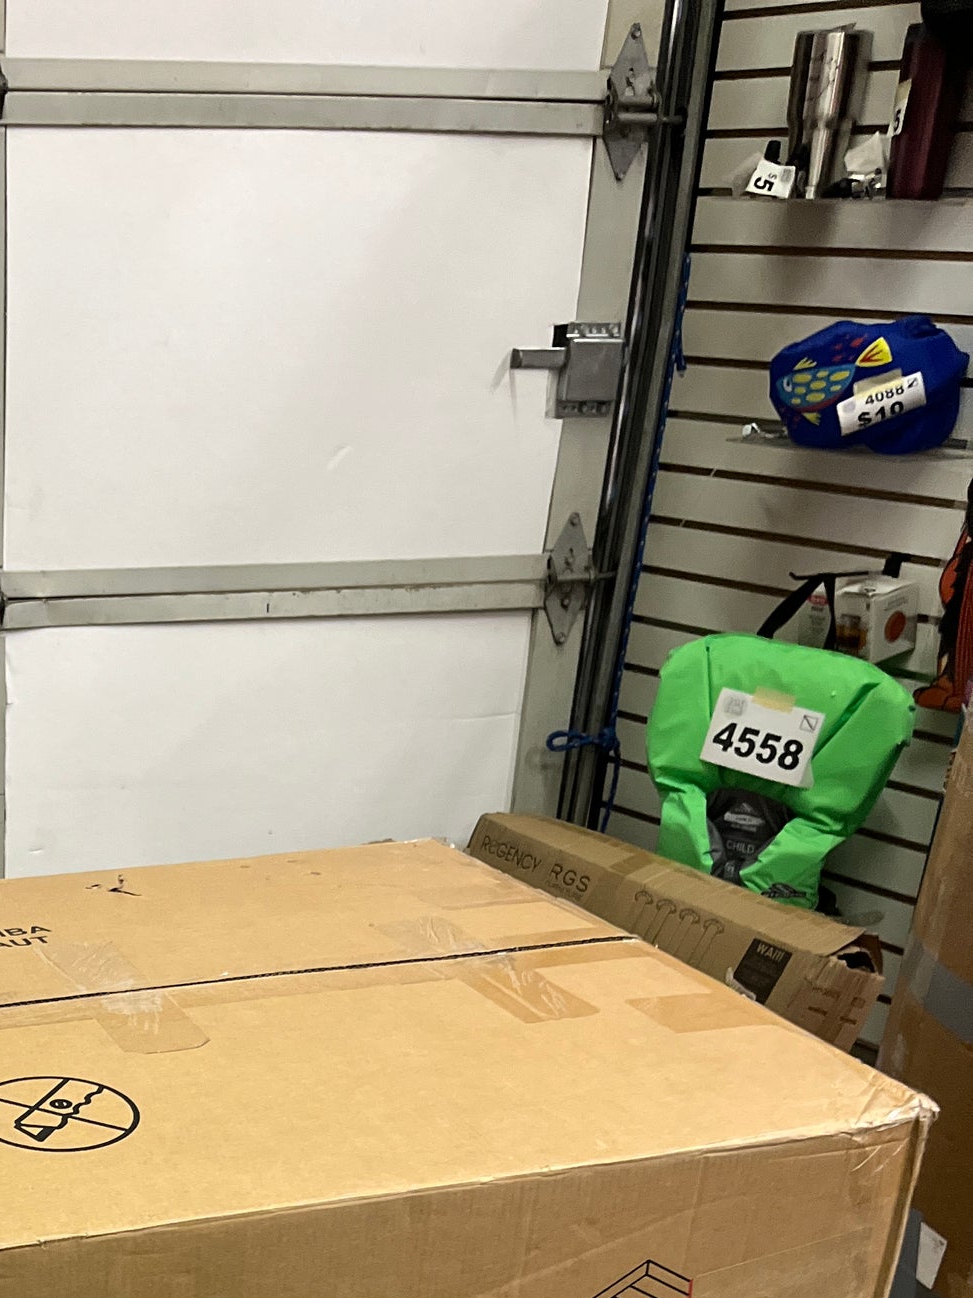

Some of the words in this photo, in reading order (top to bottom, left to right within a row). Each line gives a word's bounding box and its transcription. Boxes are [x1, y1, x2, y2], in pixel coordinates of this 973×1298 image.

[857, 401, 904, 428] $10
[712, 722, 804, 771] 4558
[549, 863, 591, 893] RGS
